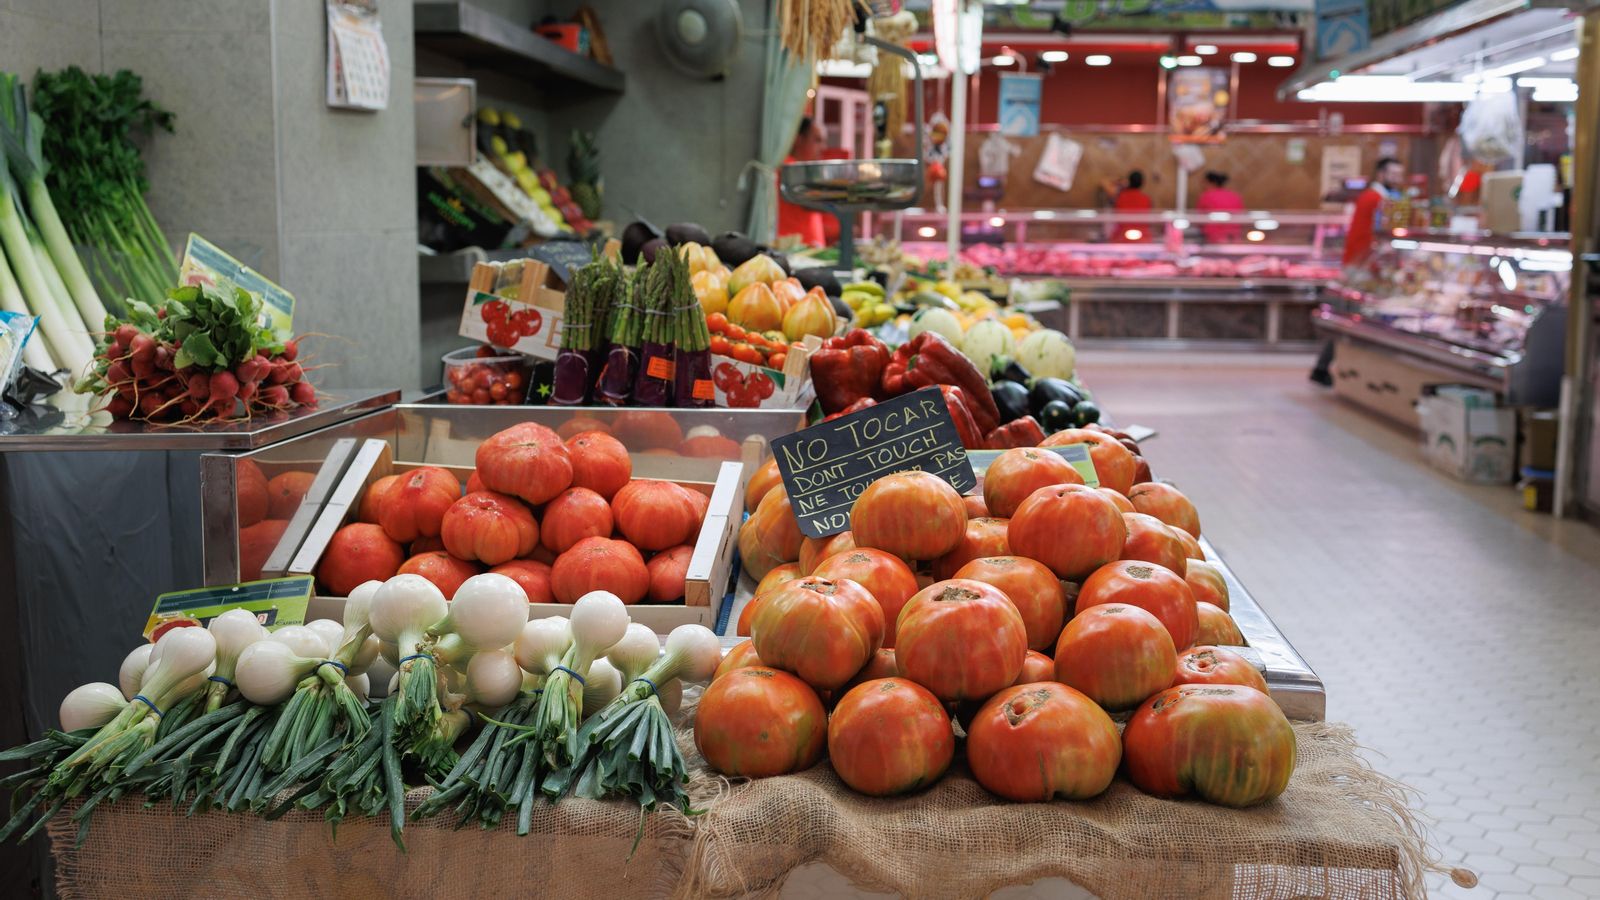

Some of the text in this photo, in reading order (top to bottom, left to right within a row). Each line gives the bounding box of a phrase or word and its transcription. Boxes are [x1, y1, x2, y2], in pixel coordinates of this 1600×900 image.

[782, 400, 941, 473] NO TOCAR
[793, 429, 938, 493] DONT TOUCH
[798, 494, 828, 514] NE
[931, 446, 967, 469] PAS
